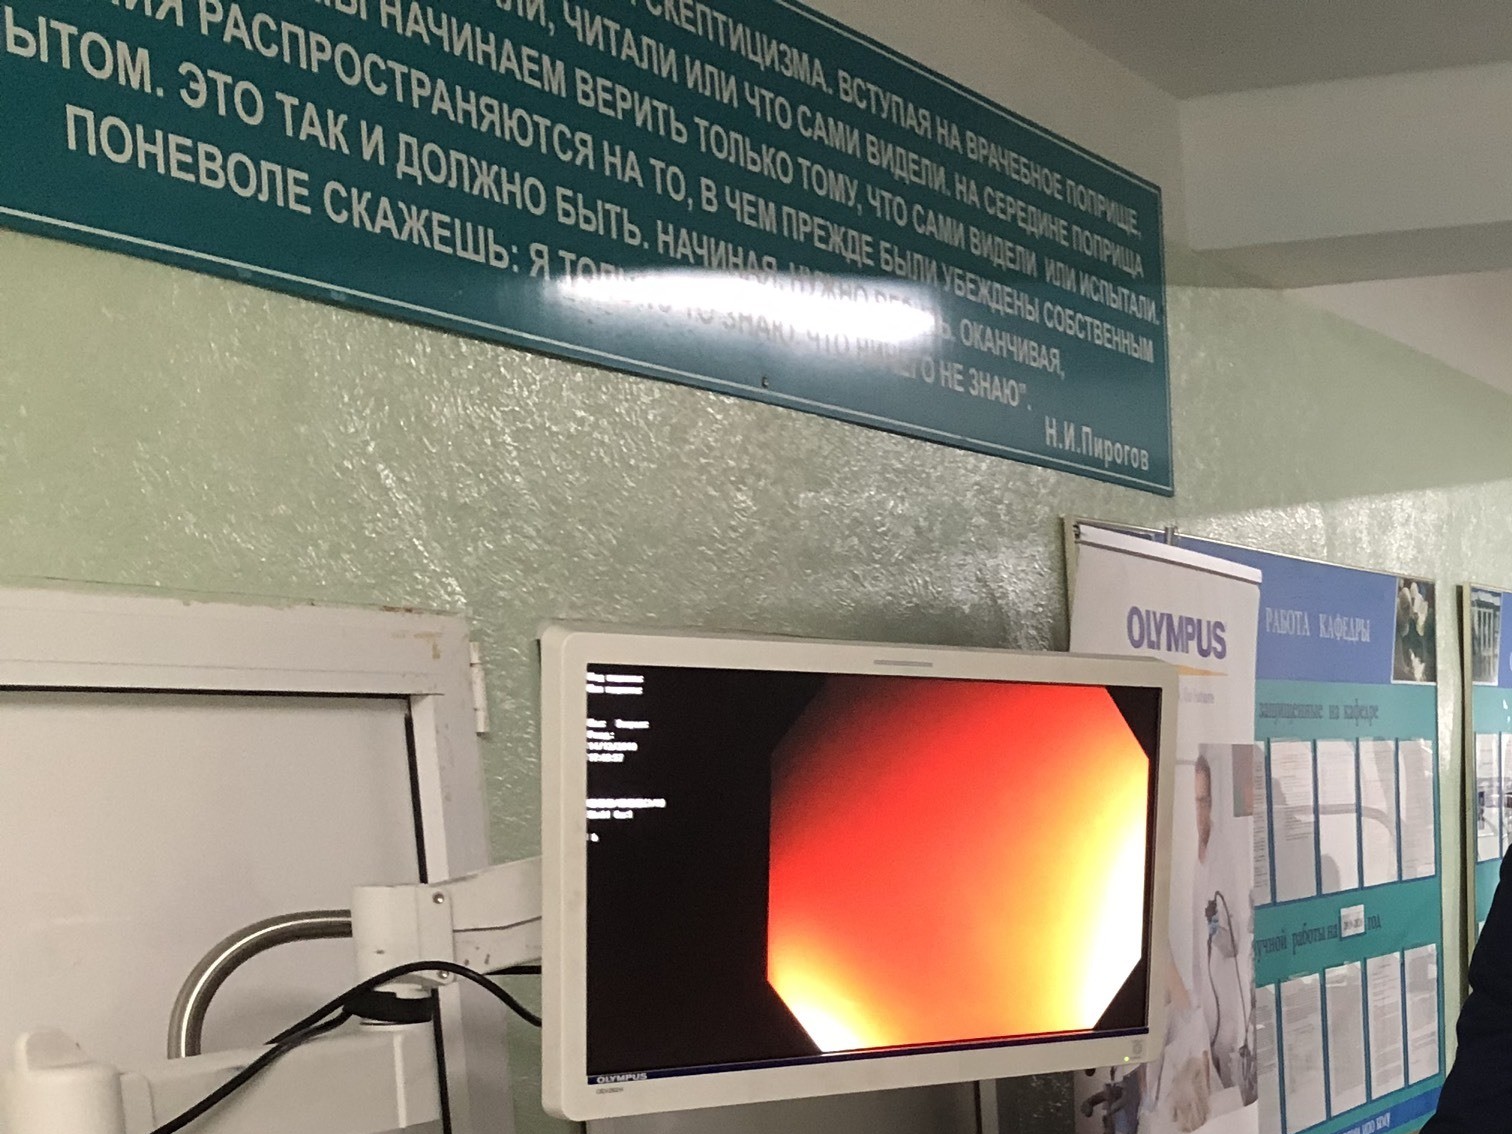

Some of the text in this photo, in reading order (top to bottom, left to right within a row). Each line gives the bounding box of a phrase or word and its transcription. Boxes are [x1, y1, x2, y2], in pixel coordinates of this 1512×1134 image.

[65, 103, 312, 215] ПОНЕВОЛЕ
[323, 180, 520, 273] СКАЖЕШЬ:
[529, 242, 551, 283] Я
[939, 360, 965, 393] НЕ
[178, 61, 265, 126] ЭТО
[275, 91, 350, 155] ТАК
[360, 119, 386, 166] И
[396, 132, 547, 216] ДОЛЖНО
[556, 185, 649, 250] БЫТЬ.
[960, 318, 1065, 380] ОКАНЧИВАЯ,
[199, 0, 595, 171] РАСПРОСТРАНЯЮТСЯ
[602, 139, 645, 188] НА
[649, 157, 694, 211] ТО,
[700, 176, 719, 213] В
[725, 185, 778, 235] ЧЕМ
[782, 205, 874, 268] ПРЕЖДЕ
[879, 240, 938, 287] БЫЛИ
[942, 262, 1040, 324] УБЕЖДЕНЫ
[1043, 301, 1155, 363] СОБСТВЕННЫМ
[379, 0, 567, 98] НАЧИНАЕМ
[575, 67, 688, 145] ВЕРИТЬ
[694, 115, 794, 185] ТОЛЬКО
[797, 157, 863, 216] ТОМУ,
[866, 184, 908, 227] ЧТО
[912, 203, 965, 250] САМИ
[969, 225, 1038, 278] ВИДЕЛИ
[1045, 257, 1077, 297] ИЛИ
[1079, 272, 1160, 325] ИСПЫТАЛИ.
[563, 0, 678, 83] ЧИТАЛИ
[685, 54, 739, 109] ИЛИ
[744, 81, 793, 131] ЧТО
[797, 105, 861, 159] САМИ
[865, 133, 950, 196] ВИДЕЛИ.
[954, 172, 981, 209] НА
[983, 186, 1070, 247] СЕРЕДИНЕ
[1071, 224, 1145, 279] ПОПРИЩА
[837, 69, 932, 140] ВСТУПАЯ
[936, 116, 963, 154] НА
[966, 131, 1063, 201] ВРАЧЕБНОЕ
[1066, 178, 1142, 239] ПОПРИЩЕ,
[1127, 605, 1227, 660] OLYMPUS
[1265, 607, 1371, 643] РАБОТА КАФЕДРЫ
[597, 1072, 648, 1084] OLYMPUS
